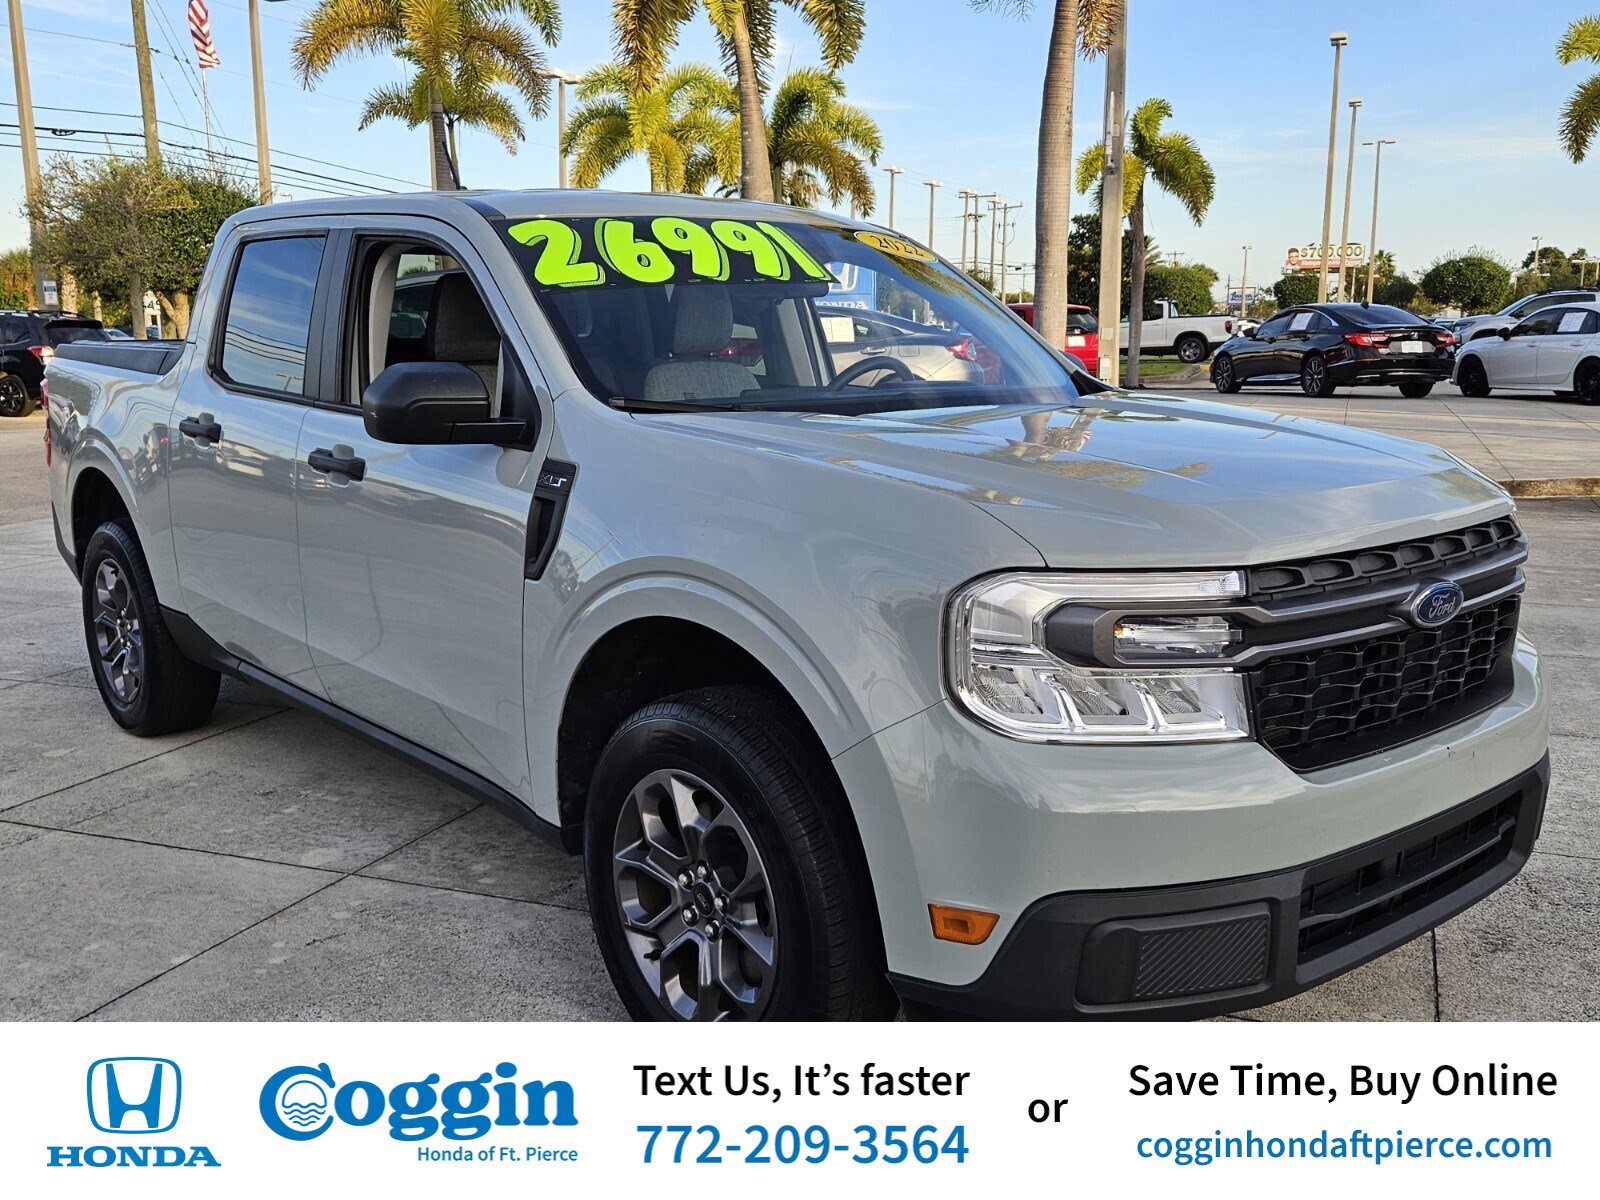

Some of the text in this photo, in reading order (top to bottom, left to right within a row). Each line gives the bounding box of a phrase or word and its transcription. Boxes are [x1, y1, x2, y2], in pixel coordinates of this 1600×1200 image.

[507, 217, 832, 288] 26991
[869, 235, 924, 256] 2022
[537, 473, 568, 488] XLT
[1428, 591, 1456, 619] Ford
